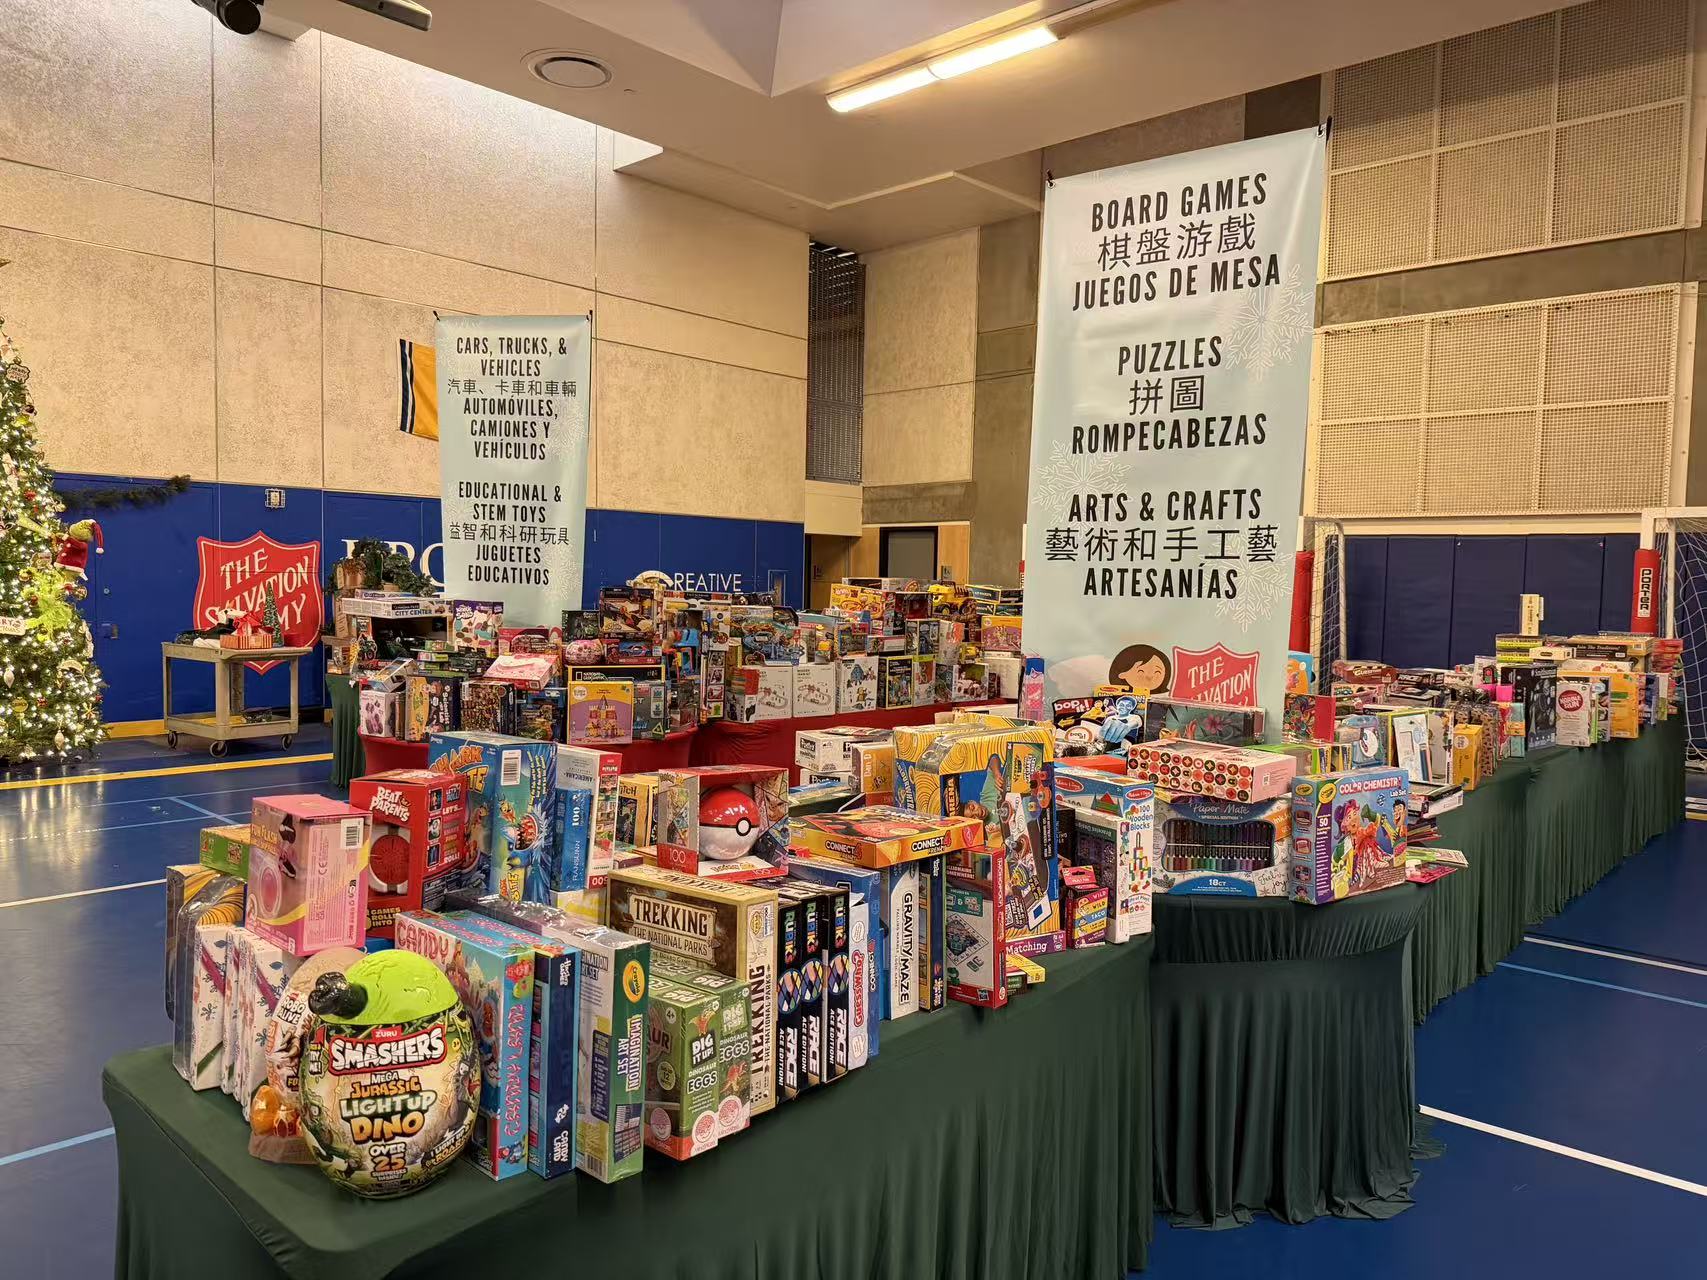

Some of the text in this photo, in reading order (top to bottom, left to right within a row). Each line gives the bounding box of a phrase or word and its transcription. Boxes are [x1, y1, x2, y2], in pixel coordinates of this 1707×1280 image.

[1092, 173, 1267, 232] BOARD GAMES
[1097, 213, 1256, 272] 棋盤游戲
[1072, 253, 1281, 312] JUEGOS DE MESA
[456, 337, 567, 357] CARS, TRUCKS, &
[1118, 335, 1222, 375] PUZZLES
[481, 359, 541, 377] VEHICLES
[464, 395, 558, 419] AUTOMÓVILES,
[1129, 375, 1205, 416] 拼圖
[471, 419, 550, 438] CAMIONES Y
[1072, 413, 1267, 454] ROMPECABEZAS
[474, 440, 546, 460] VEHÍCULOS
[459, 482, 562, 502] EDUCATIONAL &
[473, 504, 546, 523] STEM TOYS
[1069, 488, 1262, 522] ARTS & CRAFTS
[449, 522, 570, 545] 益智和科研玩具
[1045, 525, 1278, 563] 藝術和手工藝
[476, 544, 541, 563] JUGUETES
[220, 548, 268, 590] THE
[468, 564, 550, 585] EDUCATIVOS
[1084, 563, 1238, 599] ARTESANÍAS
[1640, 568, 1653, 611] PORTER
[1188, 657, 1225, 688] THE
[1054, 700, 1080, 716] bop
[377, 787, 402, 802] BEAT
[620, 786, 637, 796] ITCH
[1340, 781, 1362, 795] COLOR
[370, 796, 410, 822] PARENTS
[1140, 804, 1150, 813] 100
[1190, 803, 1250, 815] Paper Mate
[1320, 818, 1328, 827] 50
[826, 841, 855, 854] CONNECT
[912, 830, 952, 852] CONNECT 4
[634, 897, 709, 937] TREKKING
[903, 892, 913, 958] GRAVITY
[397, 920, 450, 960] CANDY
[633, 926, 709, 956] THE NATIONAL PARKS
[1006, 940, 1048, 957] Matching
[900, 958, 910, 1004] MAZE
[277, 1009, 302, 1025] ALIVE
[281, 997, 304, 1014] ROBO
[749, 965, 765, 1076] TREKKING
[375, 1029, 397, 1038] ZURU
[692, 1034, 714, 1055] DIG
[808, 1015, 820, 1075] RACE
[836, 1007, 847, 1067] RACE
[330, 1027, 445, 1070] SMASHERS
[617, 1038, 628, 1076] ART SET
[630, 1017, 641, 1090] IMAGINATION
[692, 1047, 714, 1066] IT UP!
[719, 1040, 750, 1063] EGGS
[786, 1027, 797, 1089] RACE
[371, 1072, 398, 1083] MEGA
[689, 1062, 717, 1077] DINOSAUR
[351, 1076, 421, 1099] JURASSIC
[687, 1072, 718, 1094] EGGS
[350, 1111, 426, 1144] DINO
[370, 1142, 406, 1157] OVER
[553, 1137, 561, 1162] LAND
[561, 1130, 569, 1162] CANDY
[372, 1155, 406, 1171] 25
